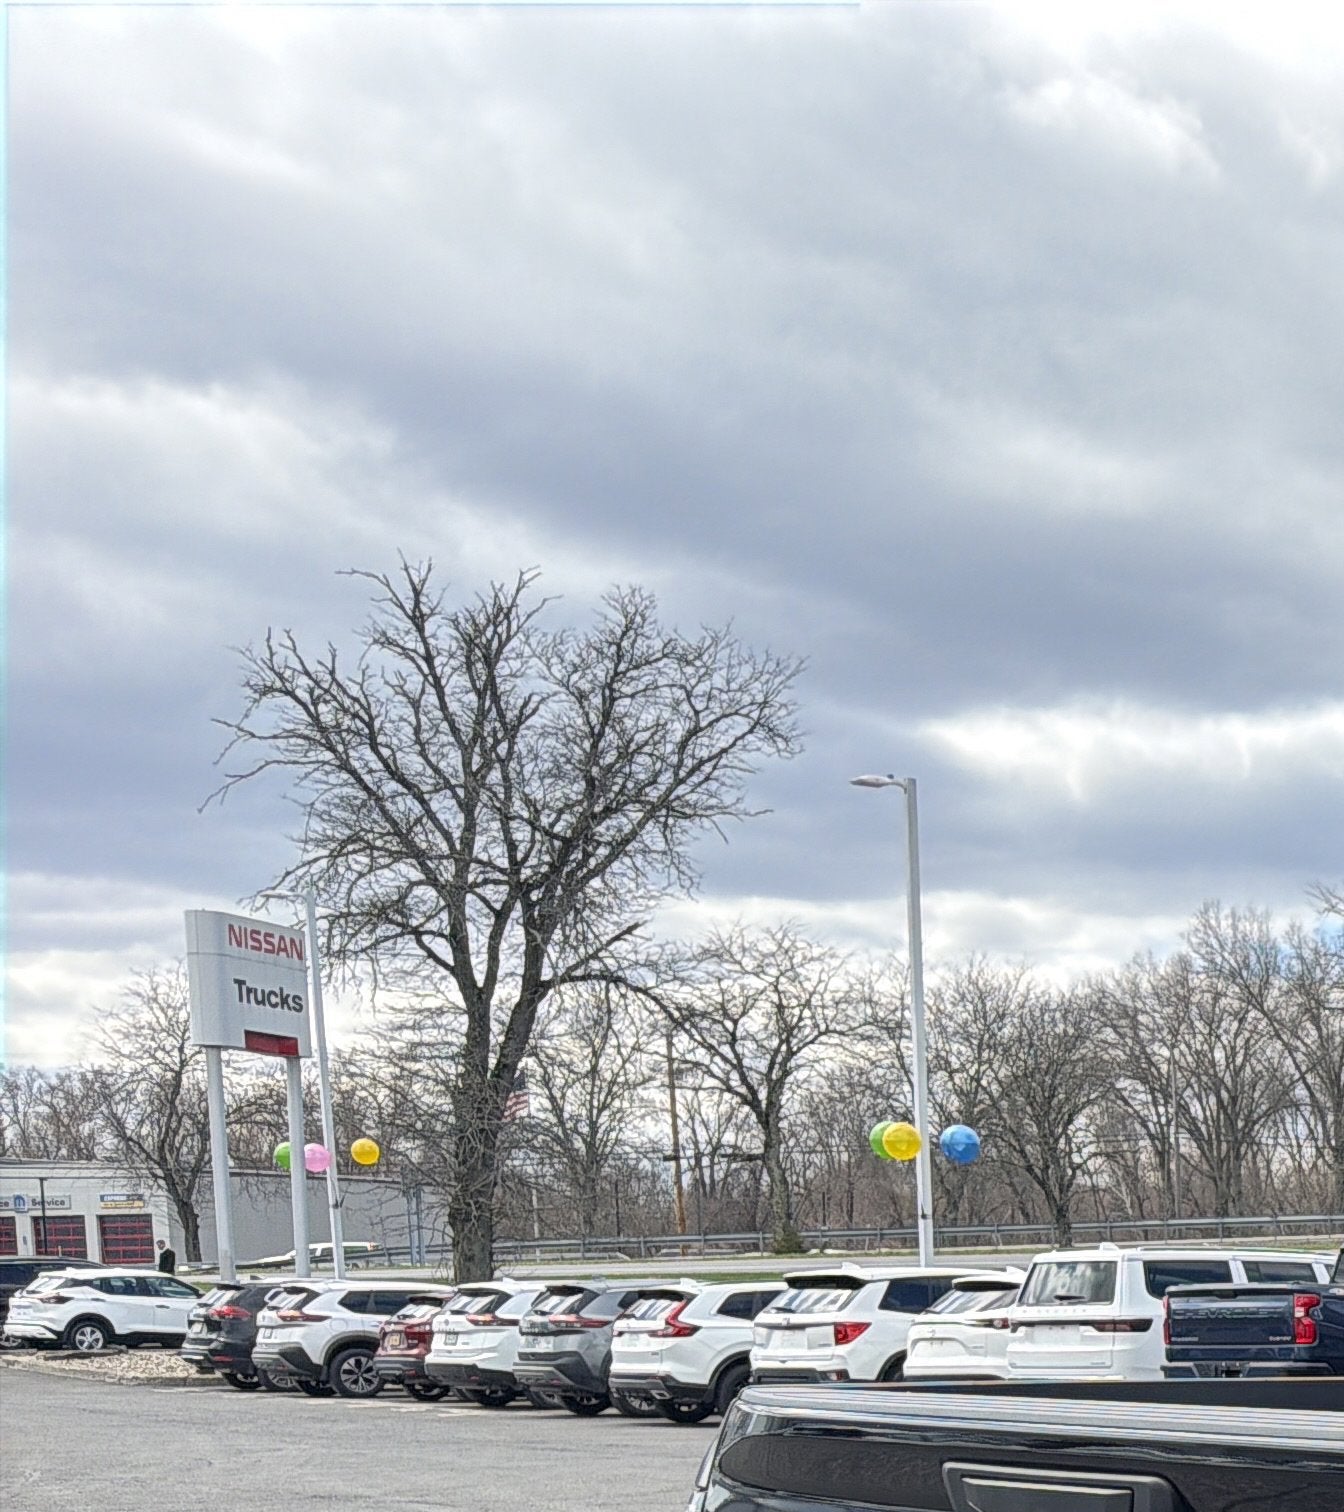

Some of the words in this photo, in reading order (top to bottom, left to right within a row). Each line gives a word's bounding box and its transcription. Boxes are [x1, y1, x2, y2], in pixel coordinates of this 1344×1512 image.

[228, 923, 304, 961] NISSAN
[233, 978, 304, 1013] Trucks
[31, 1198, 66, 1207] Sevice
